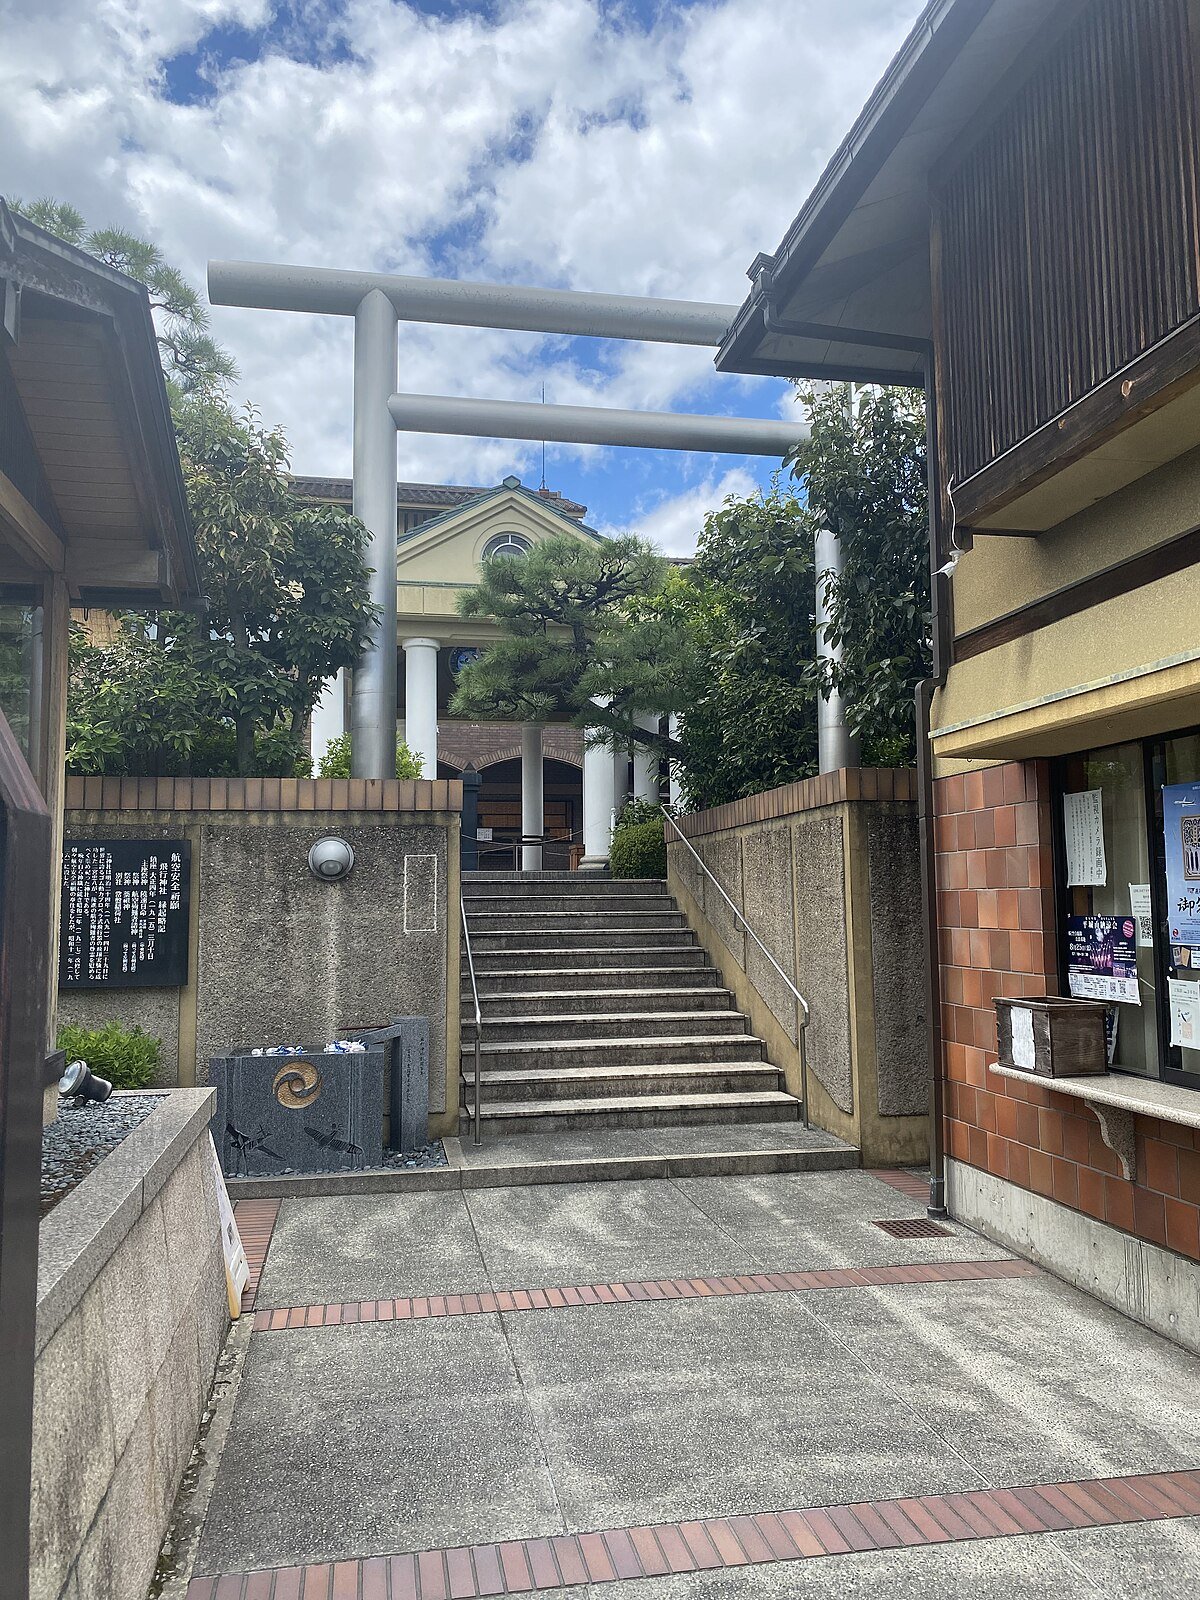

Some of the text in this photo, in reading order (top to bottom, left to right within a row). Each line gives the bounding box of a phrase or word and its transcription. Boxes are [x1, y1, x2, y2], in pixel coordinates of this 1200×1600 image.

[158, 863, 168, 933] 飛行神社 縁起略記
[170, 853, 181, 910] 航空安全祈願
